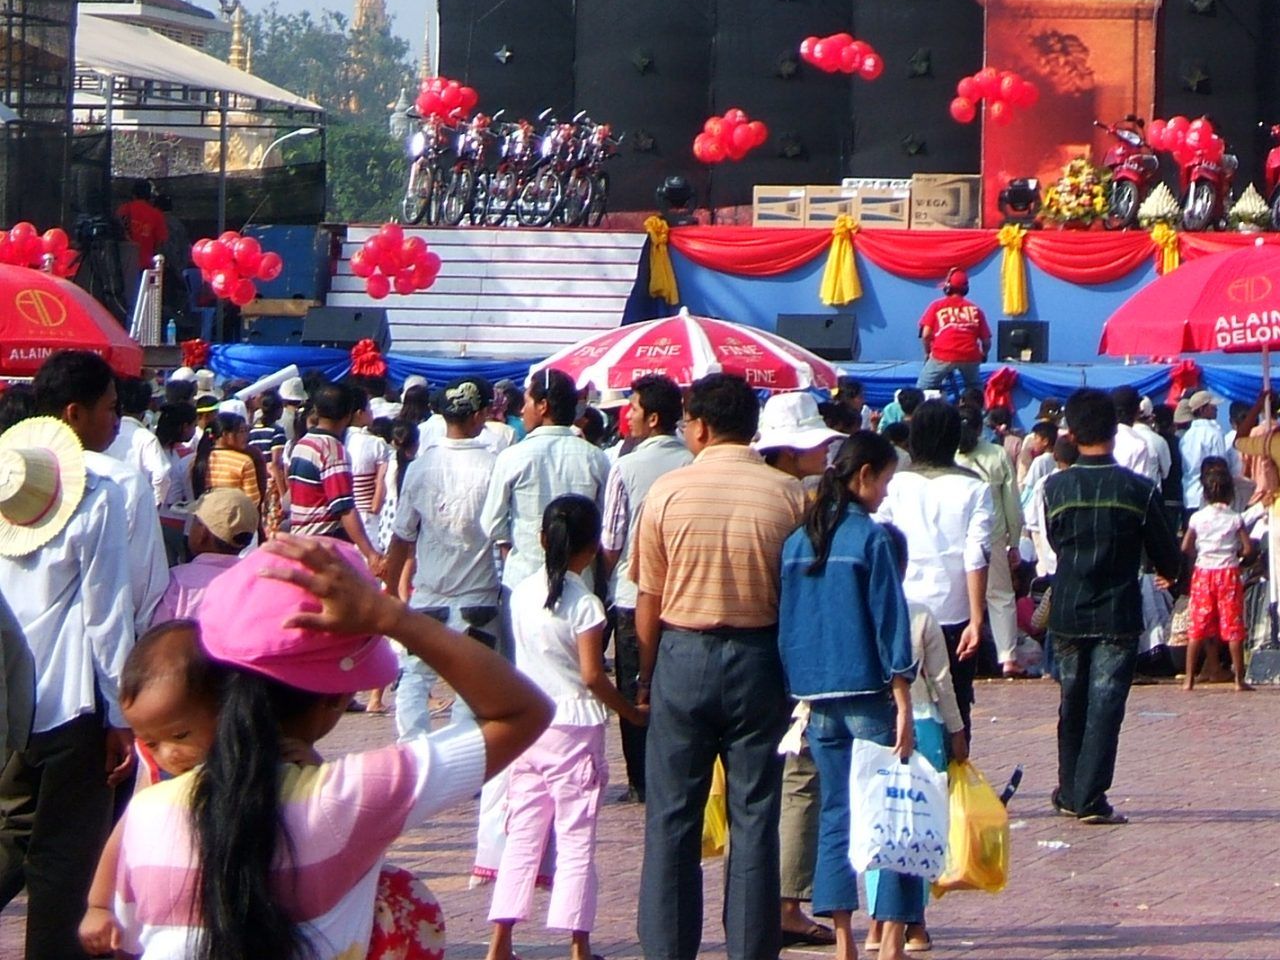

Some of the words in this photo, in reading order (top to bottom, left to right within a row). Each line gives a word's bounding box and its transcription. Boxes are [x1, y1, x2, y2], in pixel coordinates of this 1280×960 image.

[915, 198, 948, 208] WEGA
[936, 306, 980, 328] FINE
[9, 347, 52, 360] ALAIN
[635, 344, 682, 358] FINE
[718, 344, 764, 357] FINE
[744, 367, 777, 384] FINE
